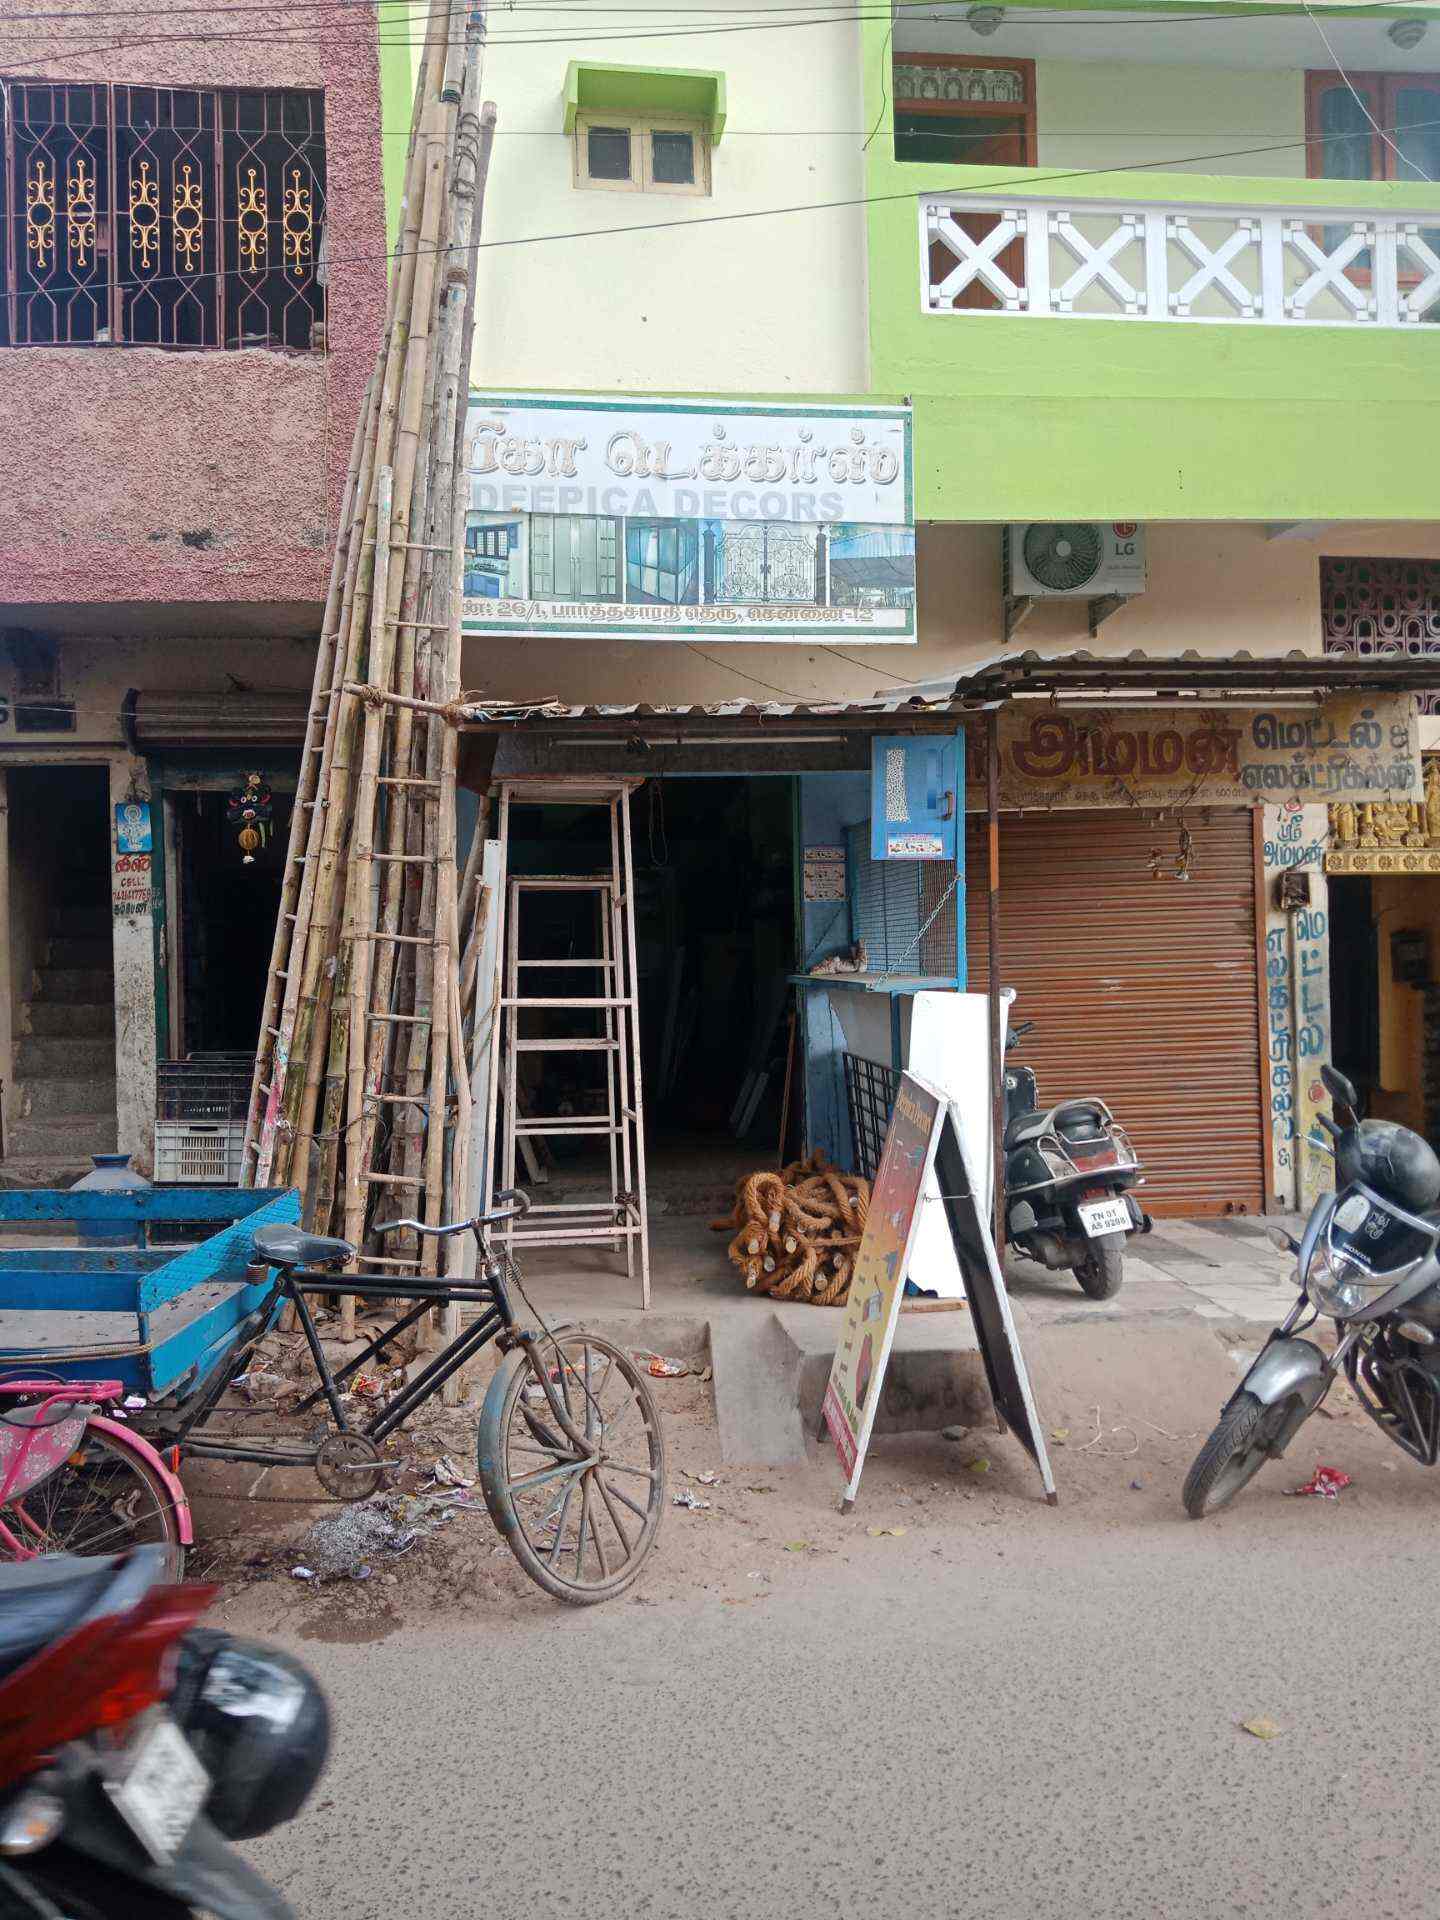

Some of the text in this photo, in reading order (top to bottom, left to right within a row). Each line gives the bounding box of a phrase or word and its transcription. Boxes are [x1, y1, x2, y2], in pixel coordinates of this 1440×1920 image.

[606, 423, 900, 485] டெக்கார்ஸ்
[472, 482, 845, 523] DEEPICA DECORS
[1114, 542, 1135, 556] LG
[1010, 709, 1244, 778] அம்மன்
[1252, 707, 1383, 750] மெட்டல்
[1091, 1211, 1105, 1221] TN
